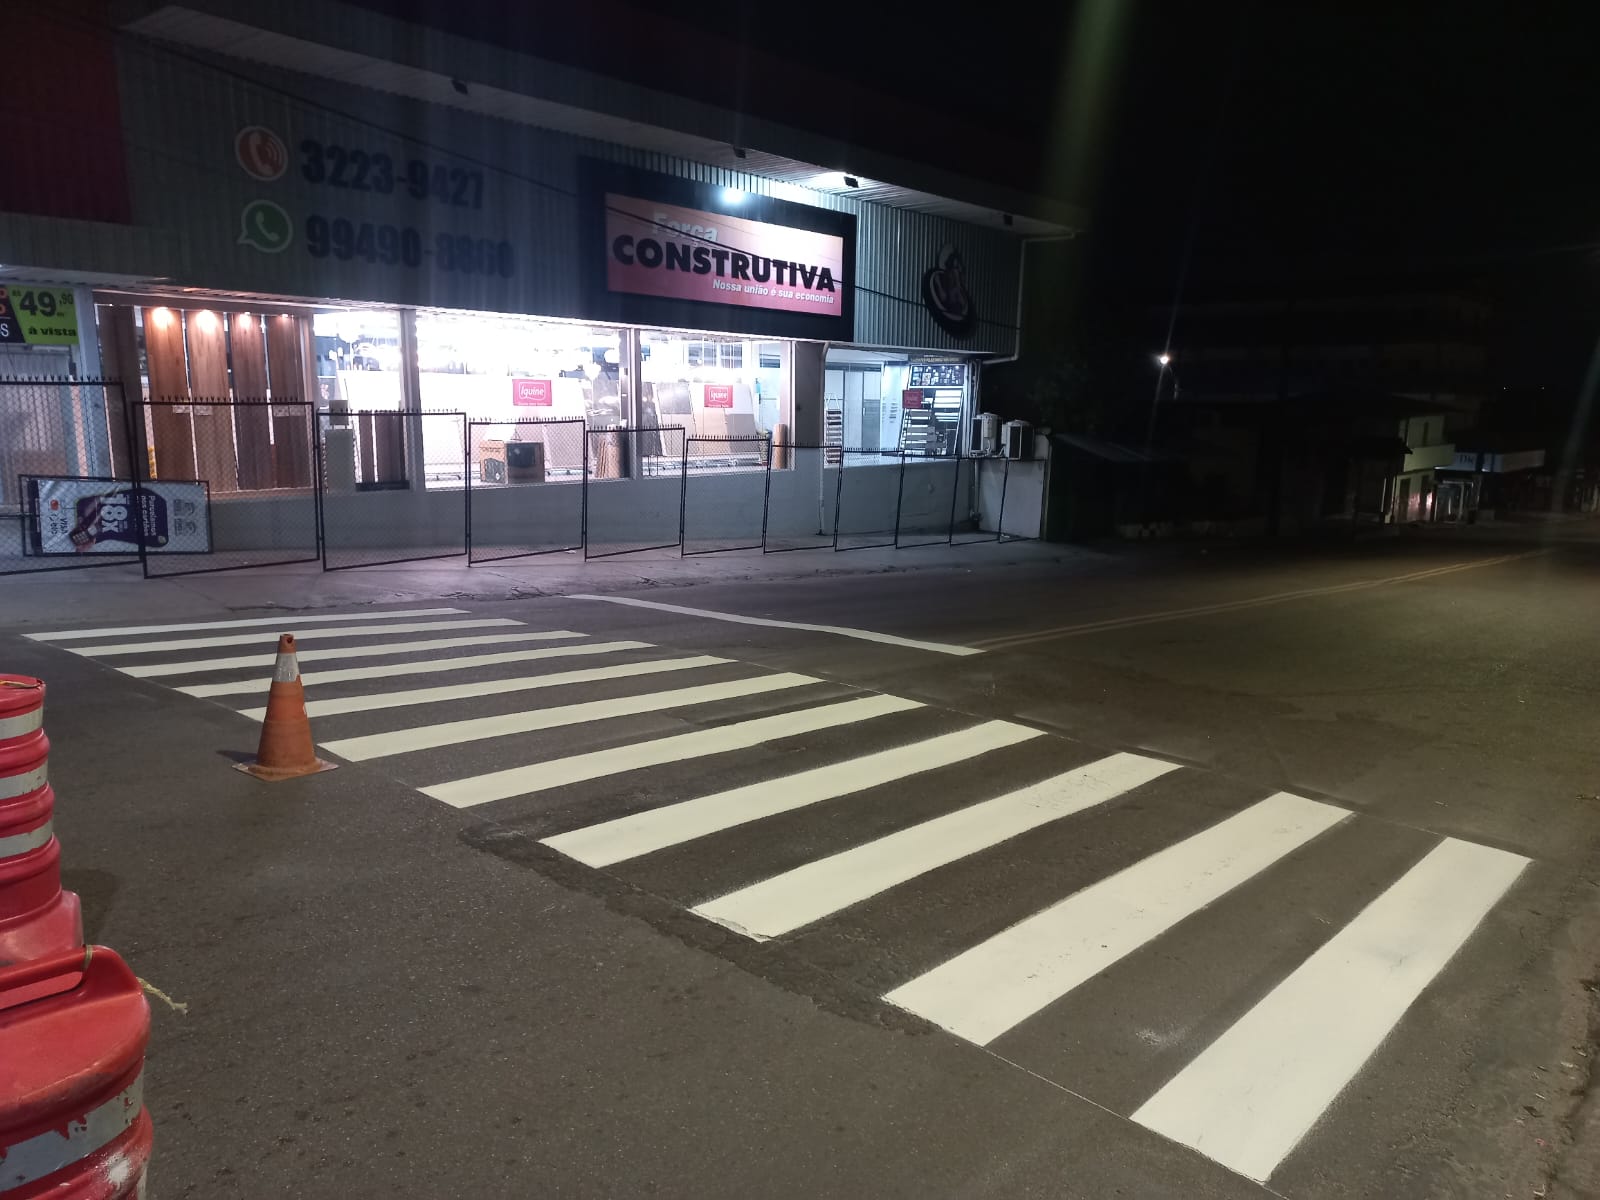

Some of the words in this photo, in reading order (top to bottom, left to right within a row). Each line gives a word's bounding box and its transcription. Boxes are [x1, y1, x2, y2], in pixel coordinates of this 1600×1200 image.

[301, 139, 483, 209] 3223-9427
[612, 234, 836, 293] CONSTRUTIVA
[713, 279, 742, 293] Nossa
[744, 284, 769, 297] união
[778, 289, 794, 299] sua
[795, 292, 835, 304] economia
[40, 327, 77, 337] vista
